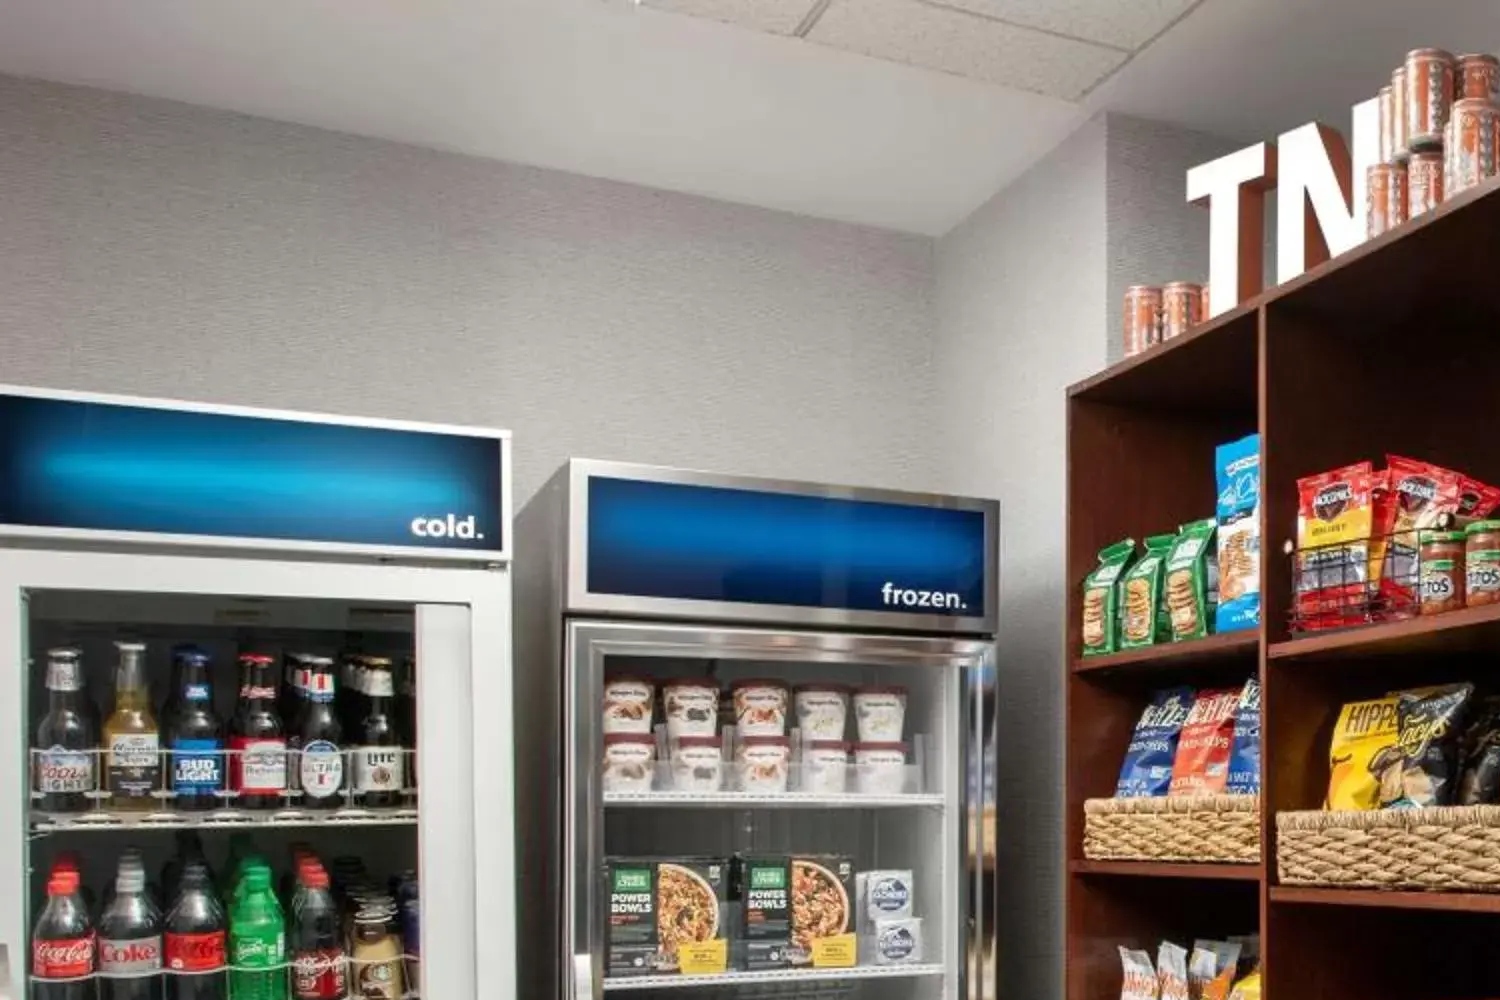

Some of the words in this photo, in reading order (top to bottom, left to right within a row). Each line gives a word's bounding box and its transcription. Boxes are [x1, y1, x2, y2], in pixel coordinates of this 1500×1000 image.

[411, 515, 484, 540] cold.
[882, 582, 967, 609] frozen.
[179, 759, 215, 770] BUD
[175, 769, 219, 782] LIGHT
[611, 893, 652, 904] POWER
[748, 889, 787, 899] POWER
[611, 903, 652, 913] BOWLS
[748, 898, 787, 909] BOWLS
